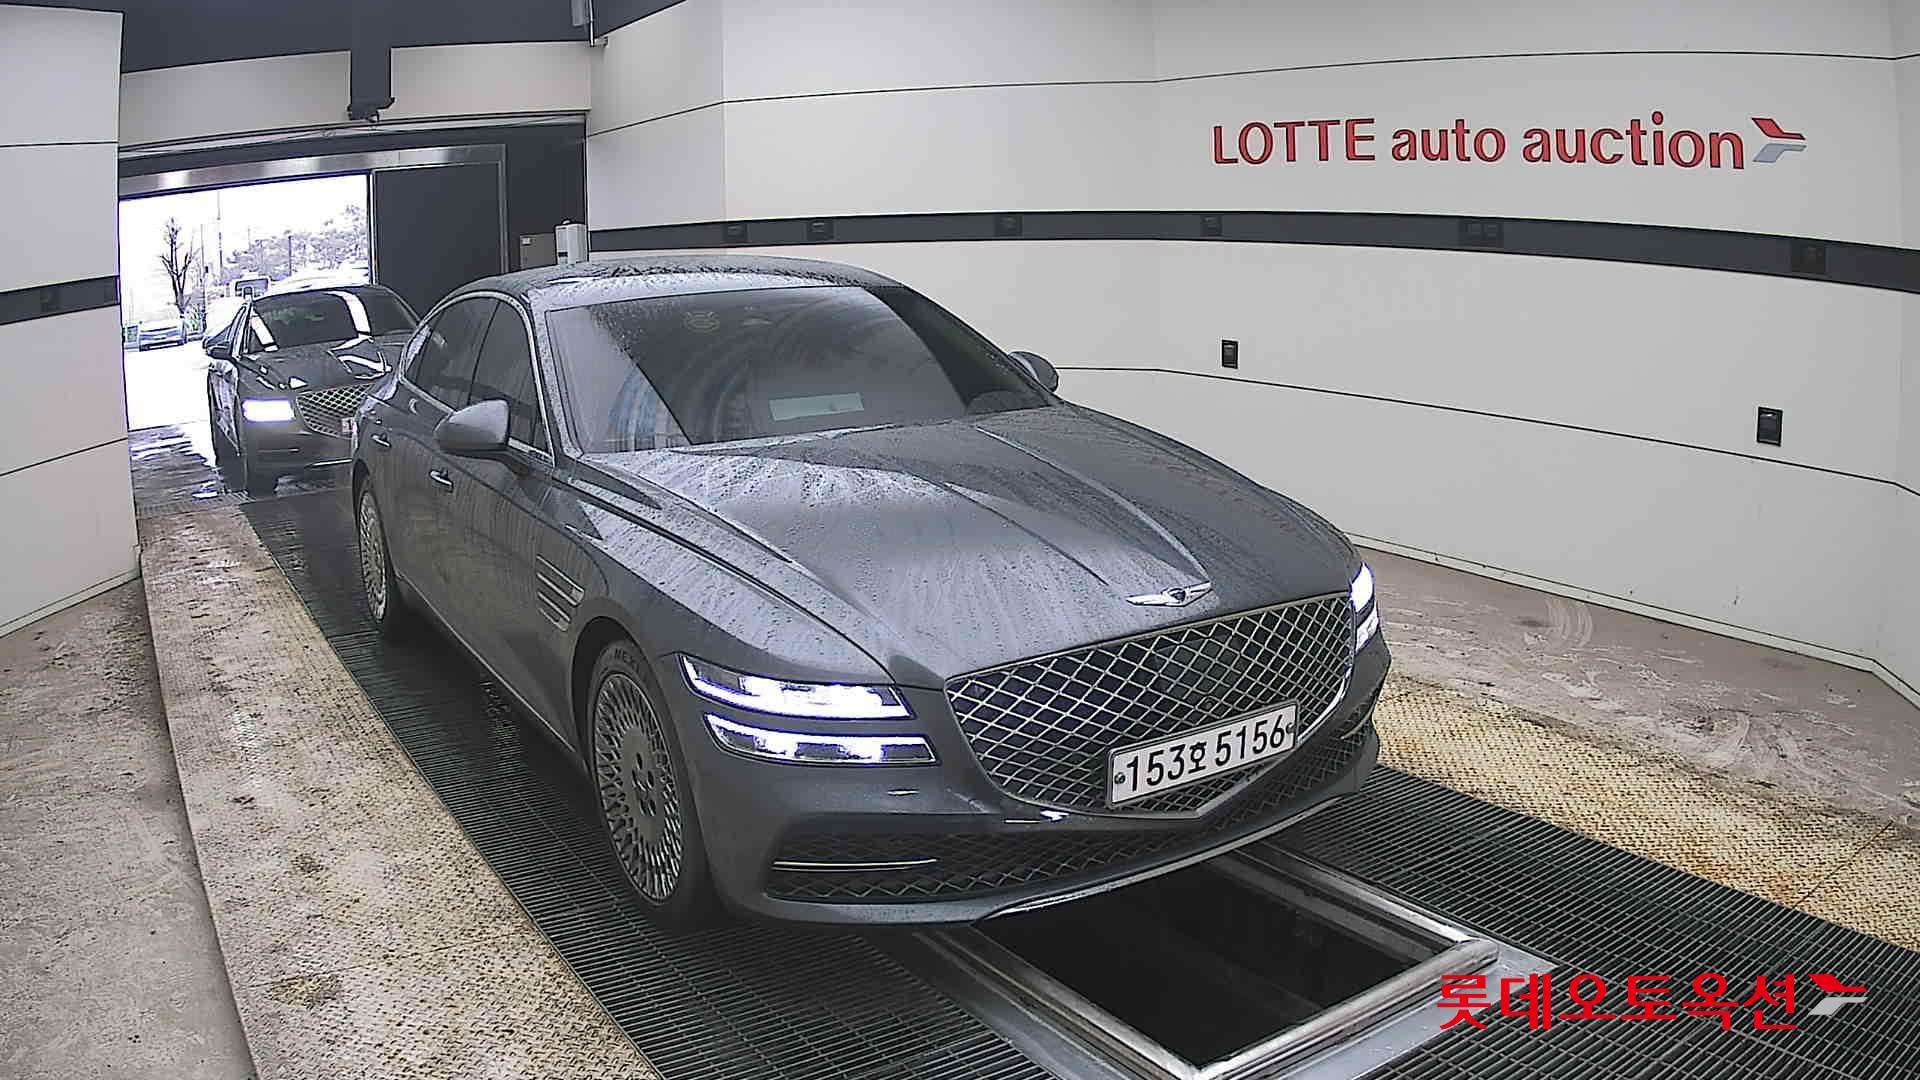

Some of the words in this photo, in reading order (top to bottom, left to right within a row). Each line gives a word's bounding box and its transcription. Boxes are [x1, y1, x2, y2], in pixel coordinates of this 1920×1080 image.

[1213, 118, 1374, 163] LOTTE
[1391, 118, 1505, 162] auto
[1522, 111, 1745, 170] auction
[1126, 741, 1207, 792] 153호
[1215, 714, 1286, 767] 5156
